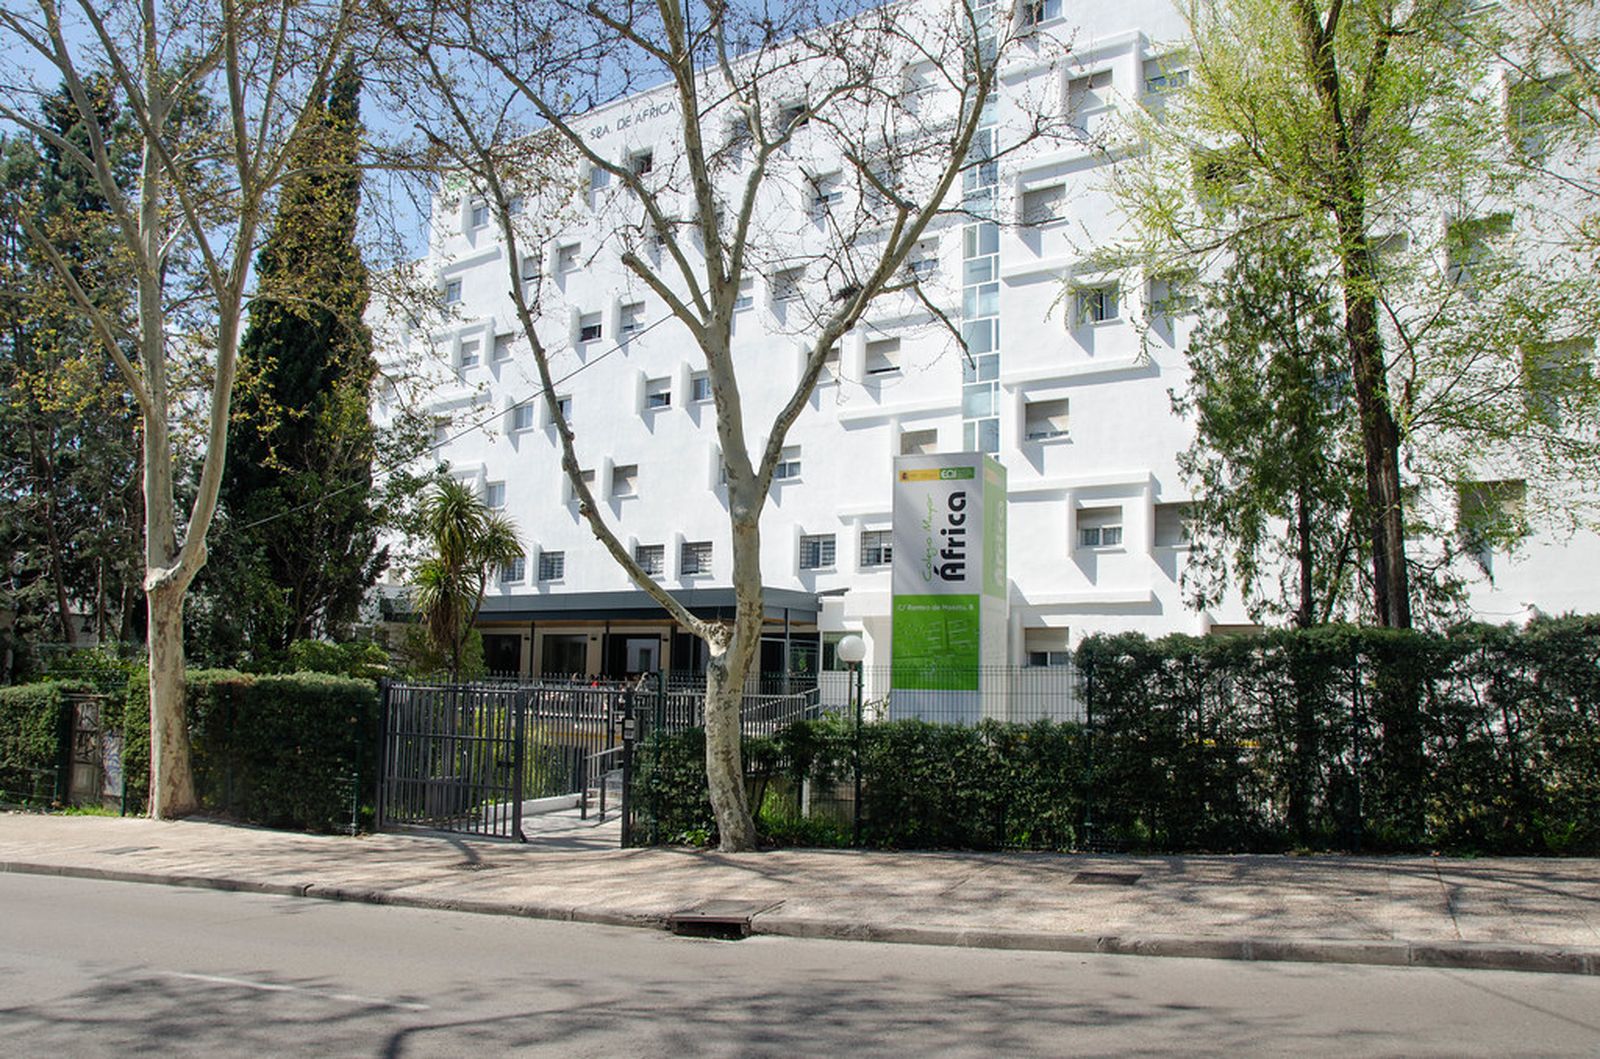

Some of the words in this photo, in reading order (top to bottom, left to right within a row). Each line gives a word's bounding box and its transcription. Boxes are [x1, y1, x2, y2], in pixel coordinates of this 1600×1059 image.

[617, 116, 632, 131] DE
[635, 101, 675, 124] AFRICA
[933, 491, 966, 582] África
